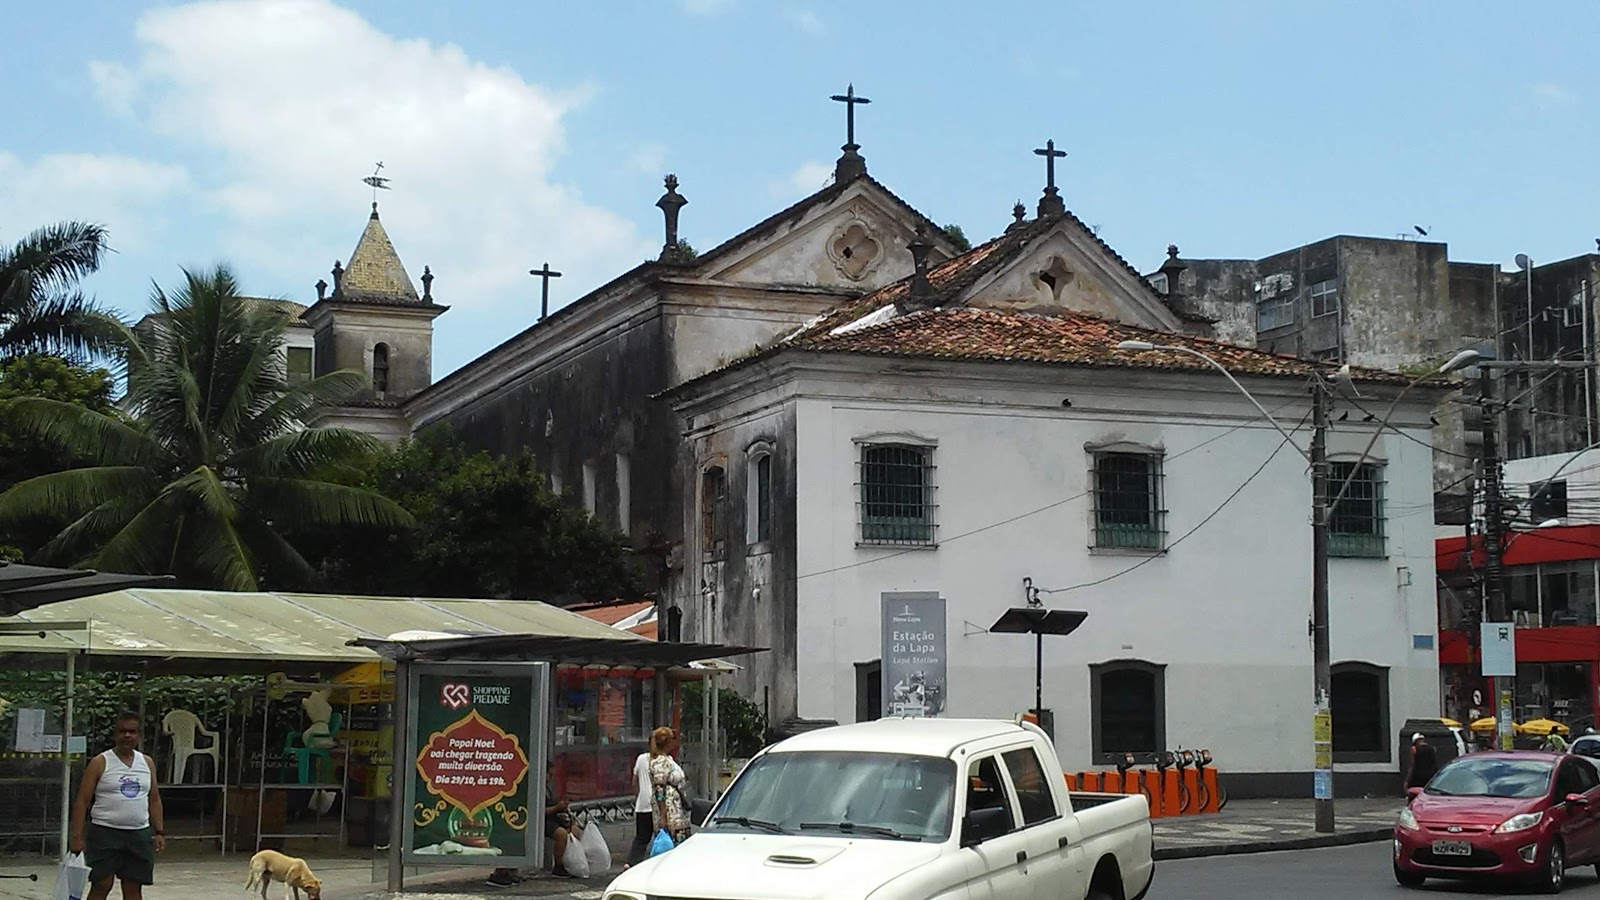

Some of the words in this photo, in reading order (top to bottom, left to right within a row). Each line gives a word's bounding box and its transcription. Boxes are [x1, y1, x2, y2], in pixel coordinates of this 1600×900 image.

[893, 631, 934, 642] Estação
[893, 643, 906, 652] da
[910, 643, 934, 654] Lapa
[473, 686, 510, 695] SHOPPING
[473, 694, 510, 704] PIEDADE
[449, 738, 474, 749] Papai
[474, 739, 495, 748] Noel
[430, 749, 444, 758] vai
[445, 750, 474, 760] chegar
[475, 750, 514, 762] trazendo
[438, 762, 463, 770] muita
[464, 762, 504, 771] diversão.
[435, 775, 449, 784] Dia
[450, 776, 476, 786] 29/10,
[478, 774, 488, 786] às
[488, 776, 506, 786] 19h.
